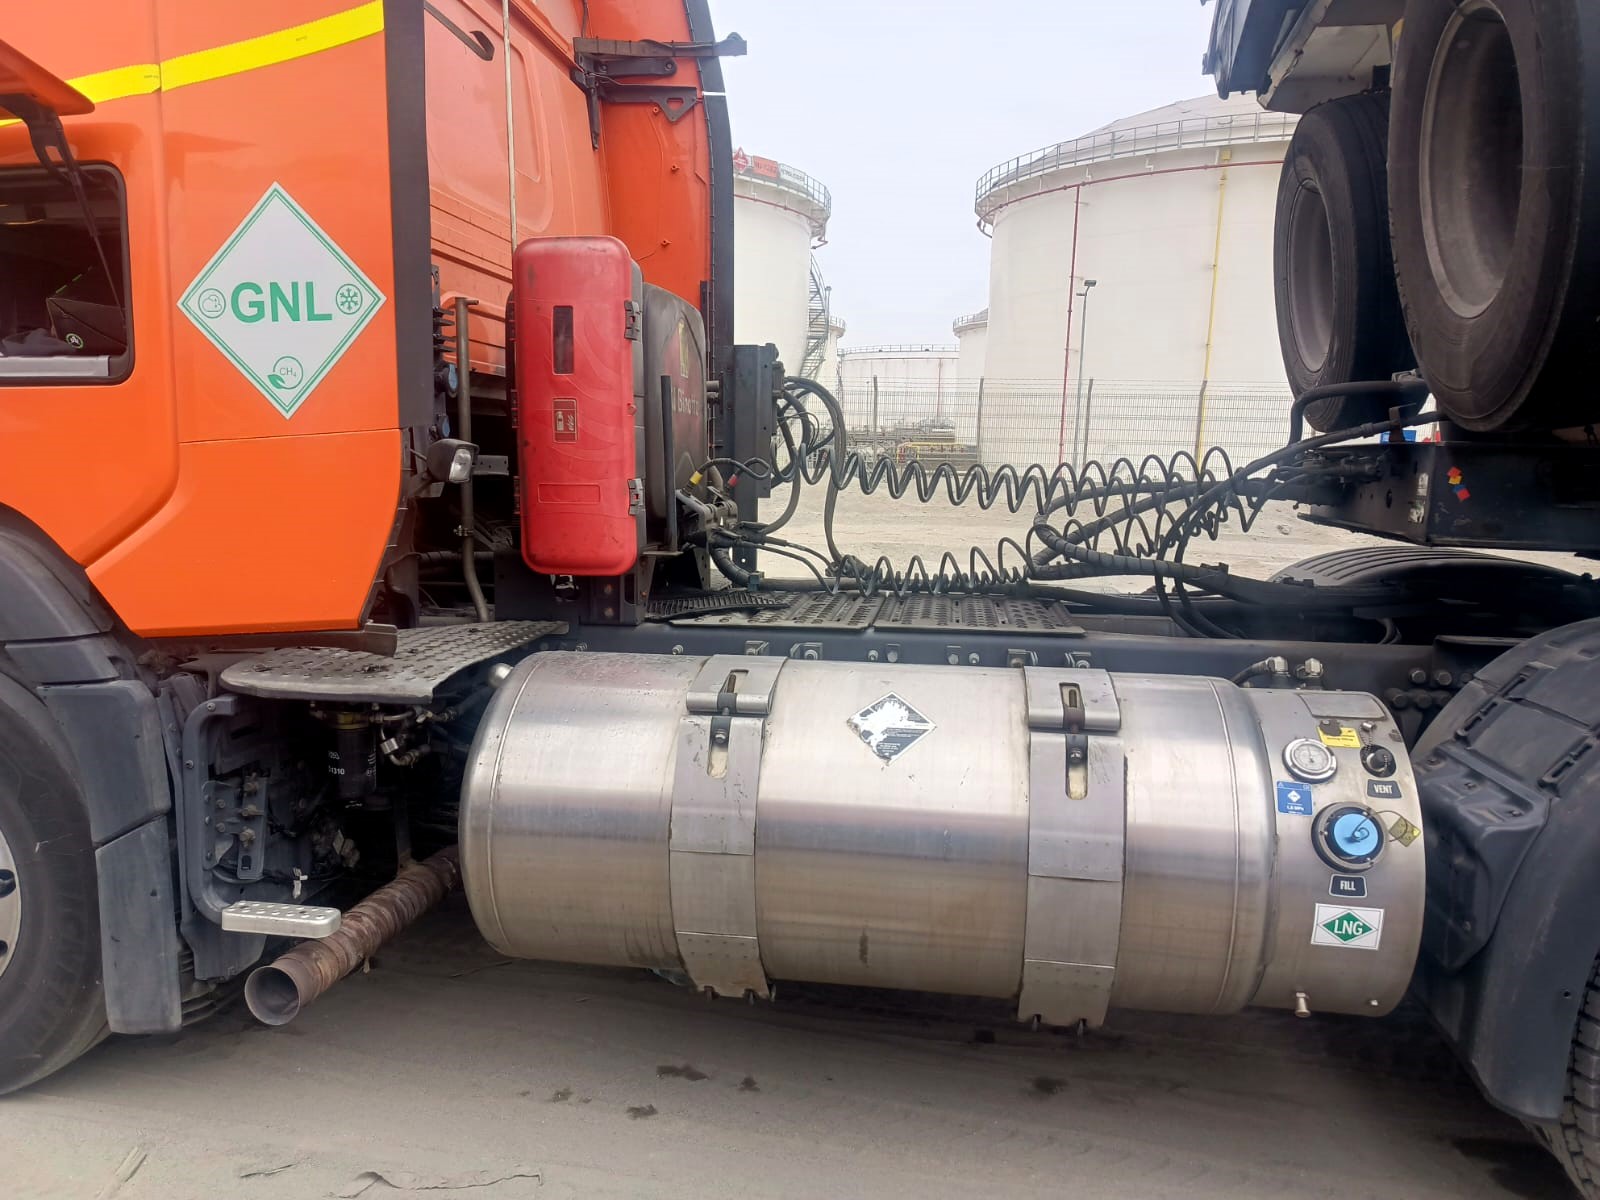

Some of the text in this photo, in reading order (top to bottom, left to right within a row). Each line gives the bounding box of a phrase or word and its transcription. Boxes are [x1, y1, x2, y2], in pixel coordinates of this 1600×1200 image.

[231, 281, 333, 323] GNL
[1373, 783, 1393, 794] VENT
[1340, 880, 1356, 891] FILL
[1333, 919, 1364, 936] LNG
